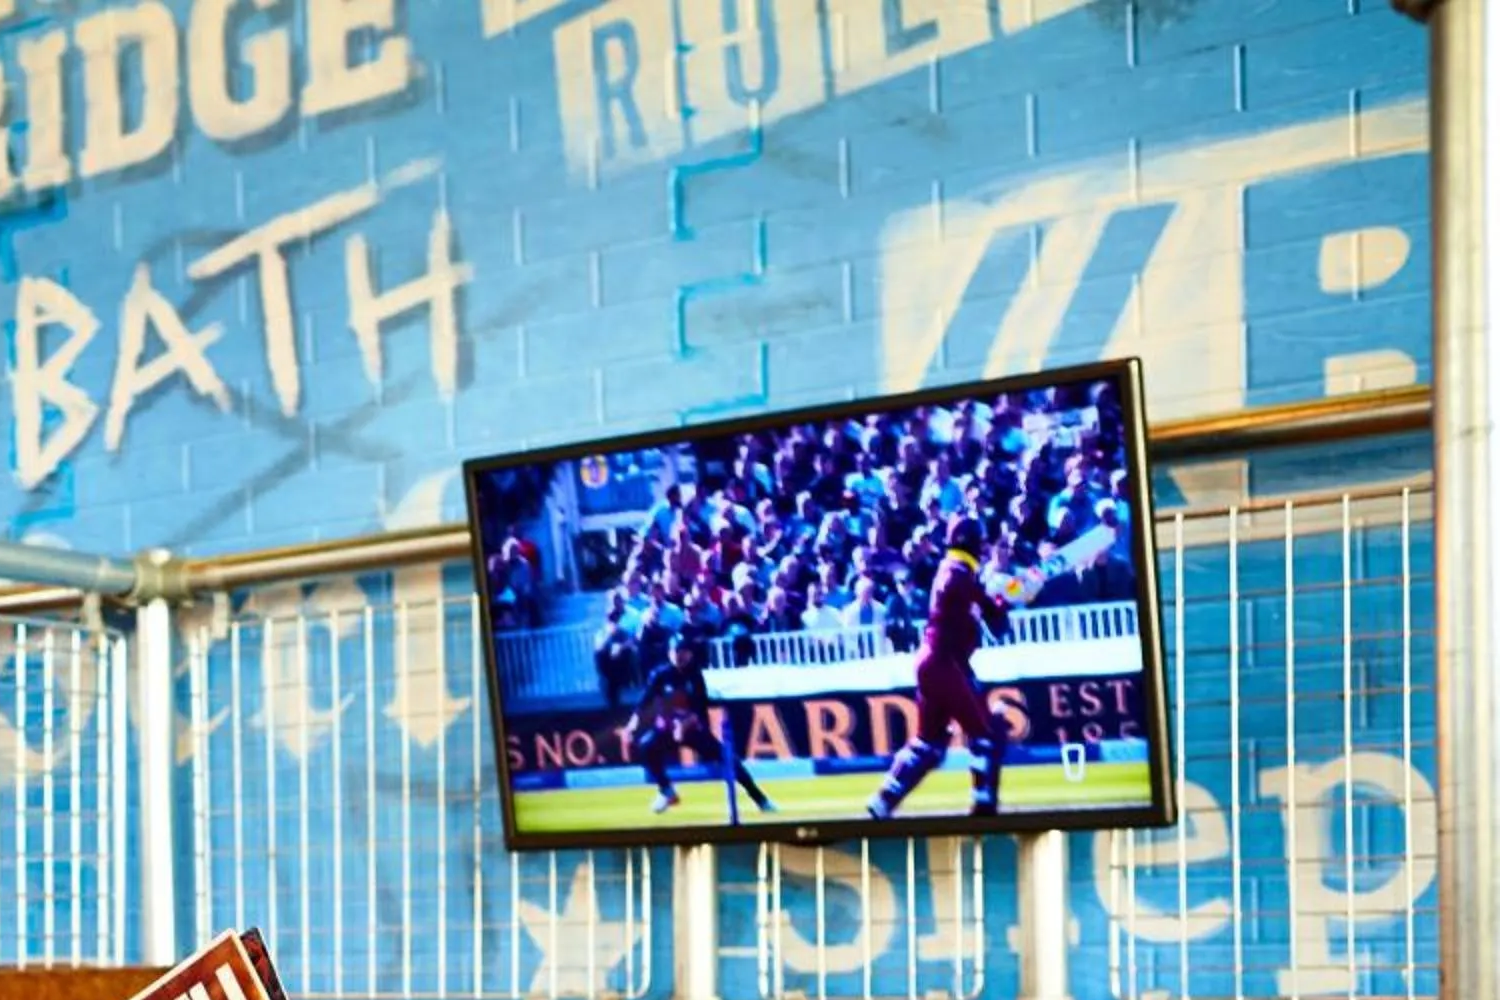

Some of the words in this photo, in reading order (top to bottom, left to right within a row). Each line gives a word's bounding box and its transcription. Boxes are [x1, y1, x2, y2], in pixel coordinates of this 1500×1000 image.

[10, 158, 473, 490] BATH
[534, 729, 606, 770] NO.
[680, 686, 1030, 767] ARDS
[1048, 680, 1134, 718] EST
